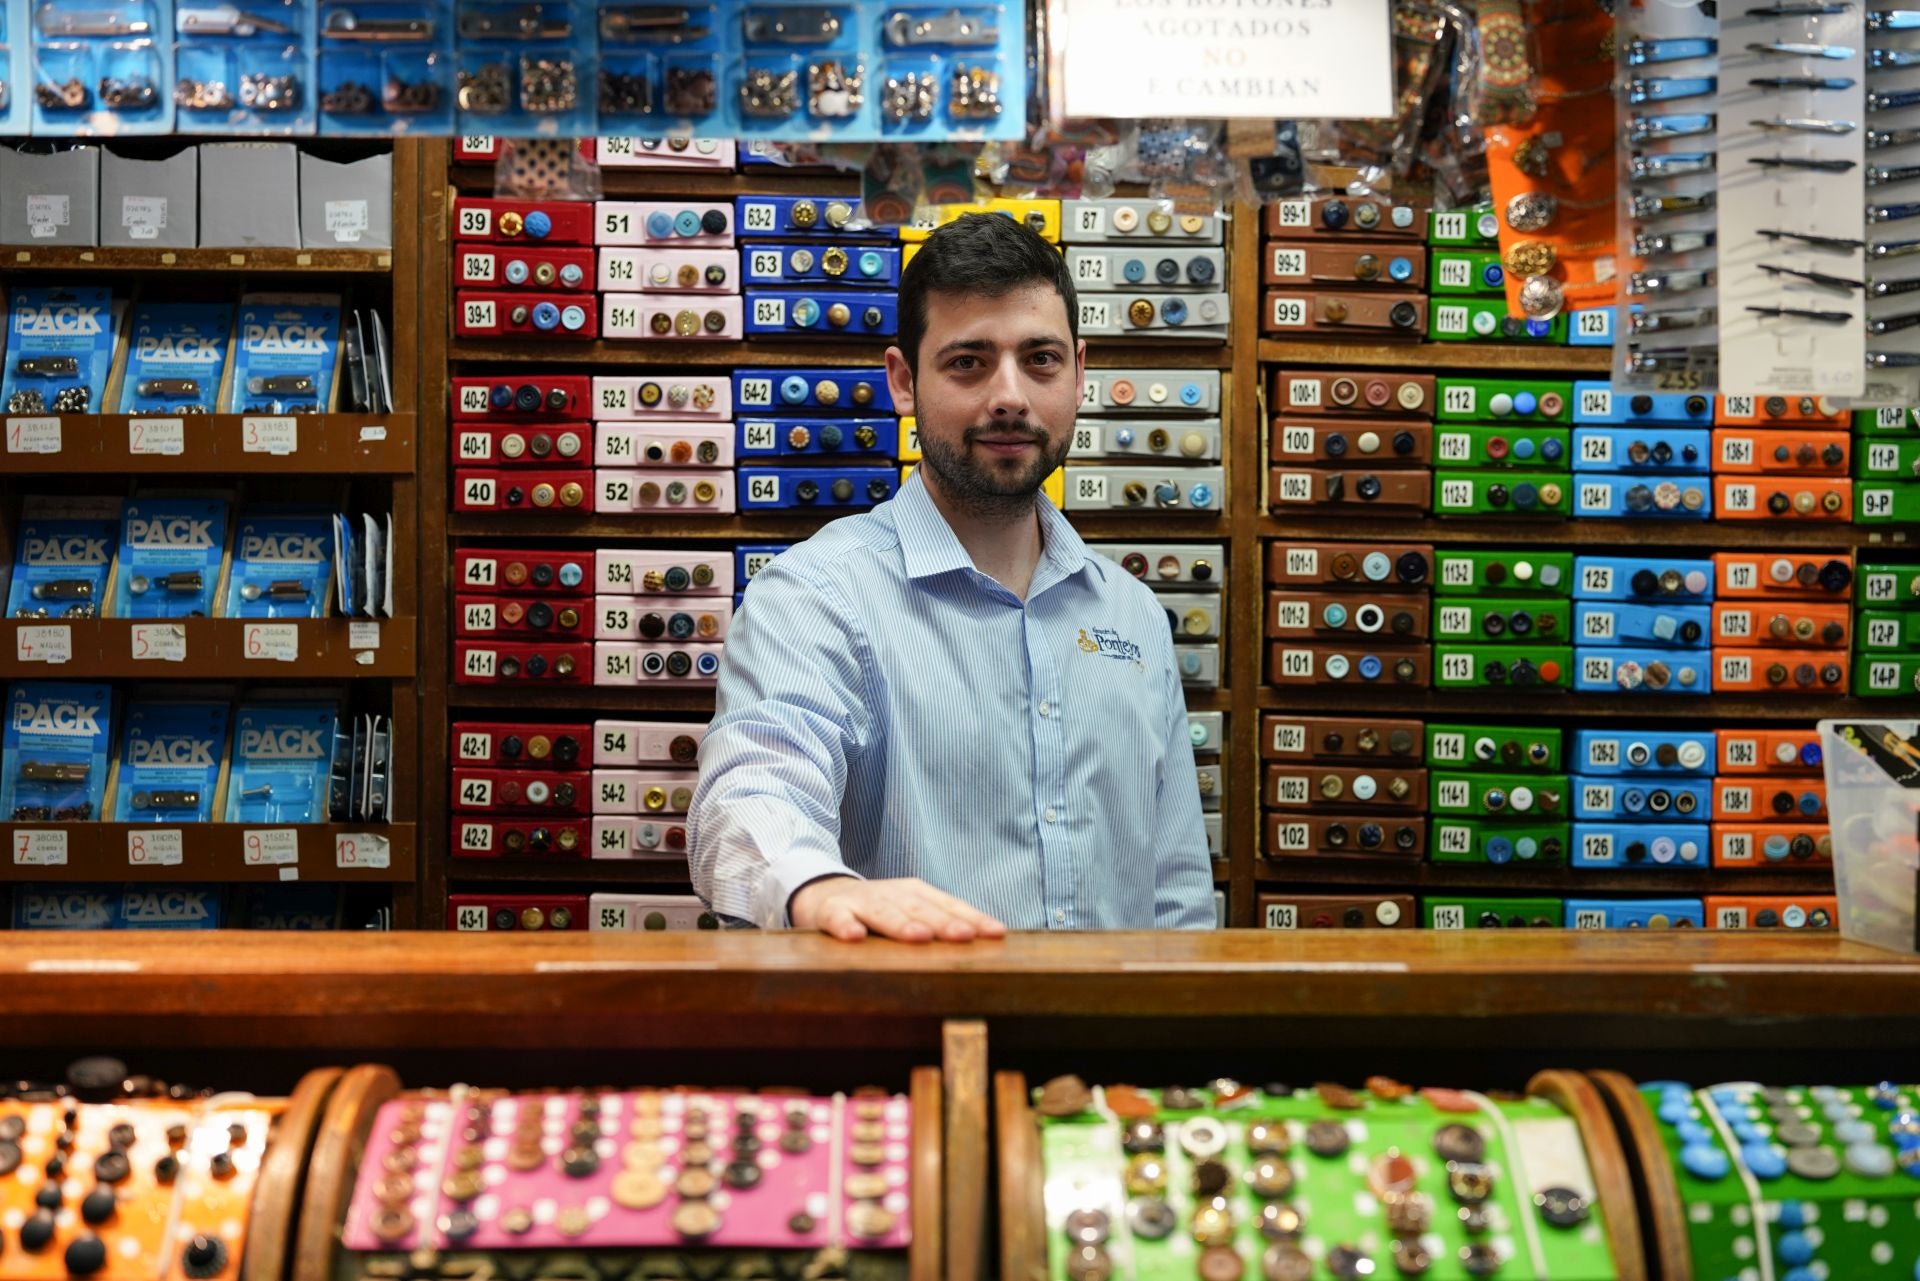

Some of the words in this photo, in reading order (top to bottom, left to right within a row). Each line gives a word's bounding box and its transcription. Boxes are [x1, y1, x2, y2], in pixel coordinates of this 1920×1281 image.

[1141, 18, 1311, 38] AGOTADOS
[1202, 47, 1248, 67] NO
[1176, 77, 1320, 97] CAMBIAN
[467, 137, 489, 148] 38-1
[608, 137, 630, 153] 50-2
[464, 213, 485, 230] 39
[749, 209, 770, 226] 63-2
[1083, 212, 1096, 229] 87
[1283, 205, 1305, 222] 99-1
[607, 215, 628, 232] 51
[1439, 218, 1460, 235] 111
[468, 258, 489, 276] 39-2
[610, 261, 632, 278] 51-2
[756, 256, 776, 272] 63
[1080, 260, 1101, 277] 87-2
[1279, 255, 1300, 271] 99-2
[1442, 265, 1465, 282] 111-2
[18, 307, 102, 335] PACK
[468, 306, 490, 323] 39-1
[612, 309, 634, 326] 51-1
[758, 304, 780, 321] 63-1
[1082, 306, 1104, 324] 87-1
[1279, 304, 1299, 321] 99
[1440, 312, 1463, 328] 111-1
[1582, 315, 1603, 332] 123
[246, 325, 329, 353] PACK
[140, 337, 221, 363] PACK
[464, 391, 488, 410] 40-2
[604, 390, 625, 407] 52-2
[745, 383, 766, 401] 64-2
[1293, 385, 1315, 402] 100-1
[1448, 392, 1469, 409] 112
[1584, 395, 1605, 411] 124-2
[1881, 408, 1902, 424] 10-P
[11, 424, 21, 449] 1
[133, 425, 145, 451] 2
[247, 423, 258, 445] 3
[748, 428, 770, 445] 64-1
[1077, 431, 1090, 448] 88
[1287, 432, 1308, 449] 100
[464, 437, 486, 454] 40-1
[607, 437, 629, 454] 52-1
[1442, 438, 1464, 456] 112-1
[1585, 441, 1606, 457] 124
[1873, 450, 1894, 466] 11-P
[468, 484, 490, 501] 40
[606, 483, 627, 500] 52
[752, 481, 773, 498] 64
[1080, 480, 1102, 497] 88-1
[1284, 479, 1306, 496] 100-2
[1444, 486, 1467, 503] 112-2
[1584, 489, 1606, 506] 124-1
[1867, 495, 1888, 512] 9-P
[130, 520, 214, 549] PACK
[27, 538, 109, 565] PACK
[243, 537, 326, 563] PACK
[1290, 555, 1312, 571] 101-1
[469, 563, 491, 581] 41
[609, 564, 630, 582] 53-2
[1446, 564, 1471, 583] 113-2
[1586, 571, 1607, 588] 125
[1734, 568, 1749, 587] 137
[1870, 579, 1892, 596] 13-P
[468, 609, 490, 626] 41-2
[606, 611, 627, 629] 53
[1282, 607, 1304, 624] 101-2
[1443, 612, 1468, 631] 113-1
[1587, 617, 1609, 634] 125-1
[1724, 615, 1748, 635] 137-2
[1872, 625, 1894, 642] 12-P
[22, 632, 34, 657] 4
[136, 630, 149, 655] 5
[249, 628, 261, 655] 6
[468, 655, 491, 672] 41-1
[608, 656, 629, 674] 53-1
[1286, 655, 1308, 672] 101
[1446, 659, 1467, 676] 113
[1586, 661, 1608, 679] 125-2
[1724, 661, 1749, 681] 137-1
[1872, 668, 1895, 687] 14-P
[18, 703, 100, 735] PACK
[243, 729, 324, 758] PACK
[463, 738, 486, 755] 42-1
[604, 734, 625, 751] 54
[1278, 730, 1300, 747] 102-1
[1437, 739, 1458, 755] 114
[133, 739, 215, 768] PACK
[464, 784, 486, 802] 42
[602, 784, 624, 802] 54-2
[1281, 782, 1304, 799] 102-2
[1441, 786, 1466, 806] 114-1
[465, 828, 487, 847] 42-2
[602, 830, 624, 848] 54-1
[1282, 827, 1304, 845] 102
[1442, 832, 1467, 851] 114-2
[17, 836, 31, 861] 7
[132, 836, 146, 861] 8
[248, 835, 261, 861] 9
[338, 840, 356, 863] 13
[1586, 839, 1608, 856] 126
[26, 895, 110, 923] PACK
[124, 893, 208, 920] PACK
[460, 910, 483, 928] 43-1
[602, 909, 624, 927] 55-1
[1270, 909, 1291, 927] 103
[1436, 911, 1458, 929] 115-1
[1578, 914, 1600, 929] 127-1
[1724, 912, 1740, 929] 139
